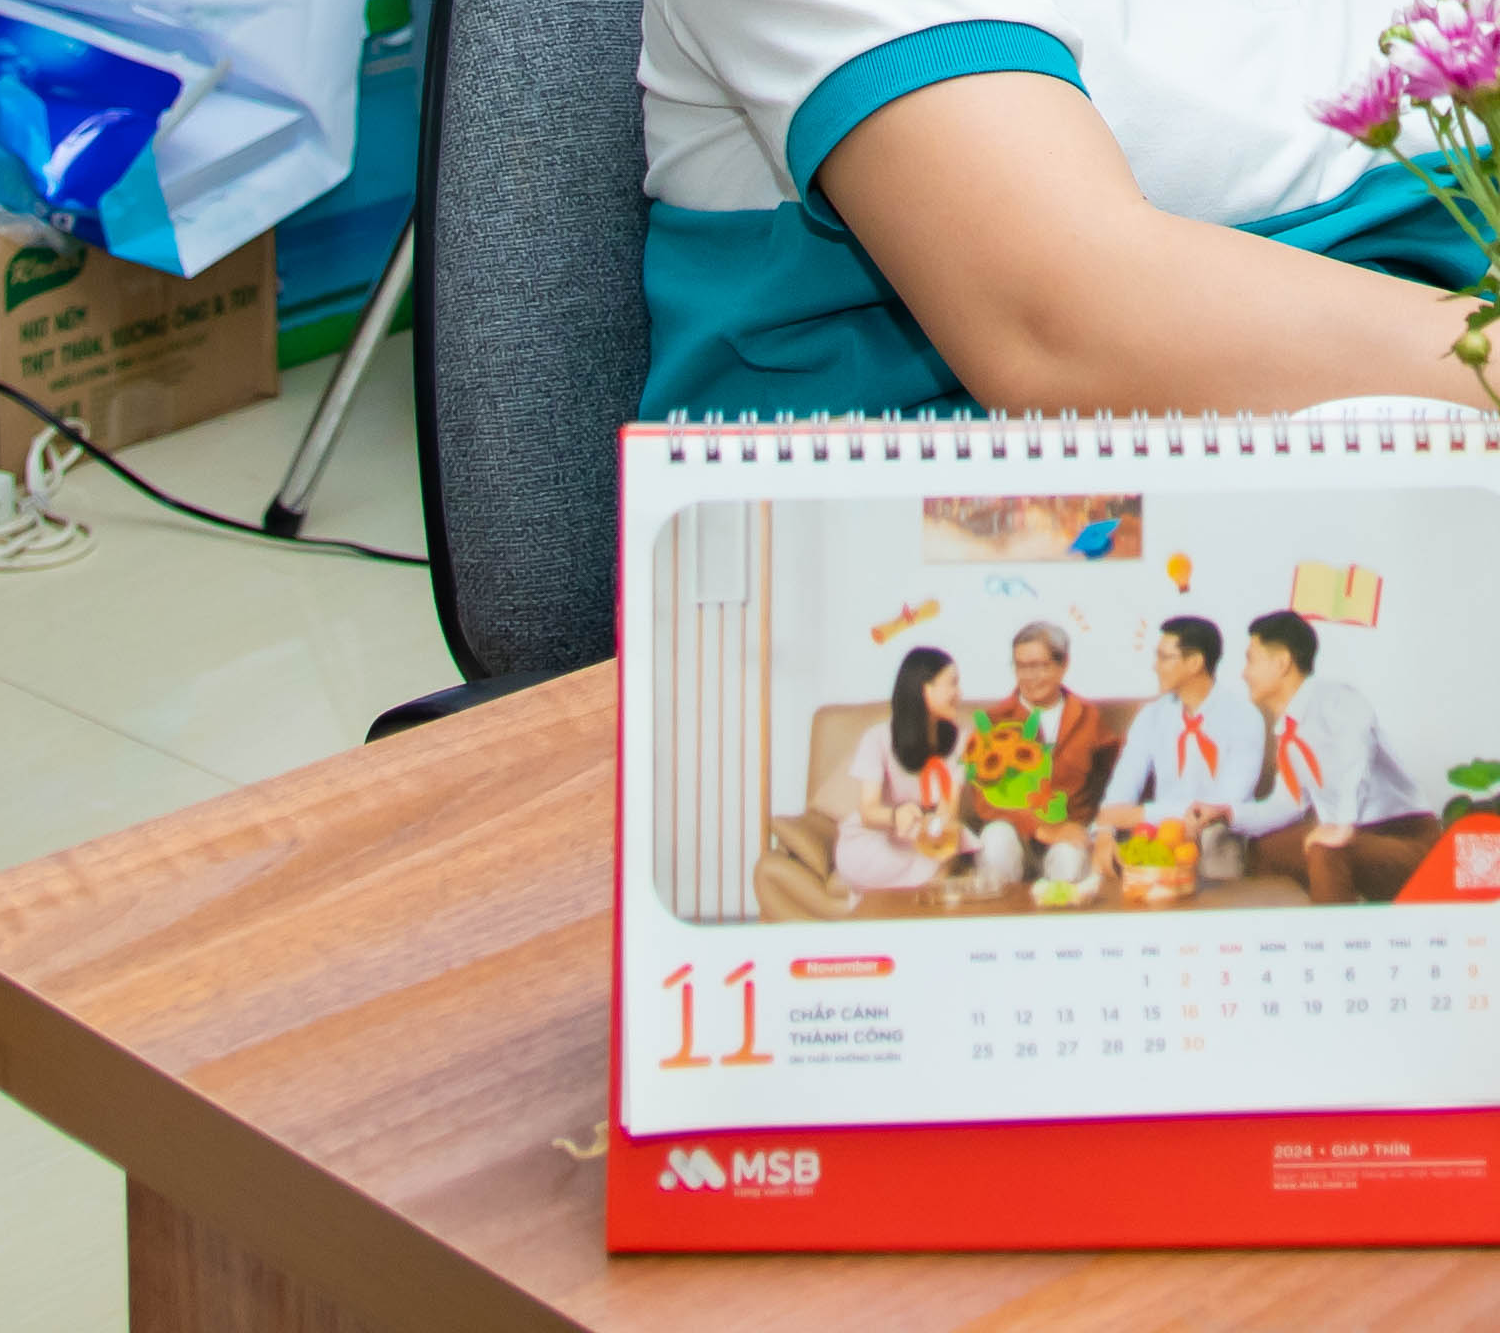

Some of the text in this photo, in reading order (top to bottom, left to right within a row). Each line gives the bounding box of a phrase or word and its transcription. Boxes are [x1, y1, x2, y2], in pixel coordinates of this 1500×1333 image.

[806, 961, 879, 976] November
[659, 960, 774, 1069] 11
[971, 1012, 986, 1025] 11
[1015, 1009, 1033, 1025] 12
[1057, 1008, 1075, 1023] 13
[1102, 1006, 1120, 1021] 14
[1144, 1005, 1161, 1021] 15
[1220, 1003, 1238, 1018] 17
[1261, 1001, 1279, 1016] 18
[1305, 1000, 1323, 1015] 19
[1346, 999, 1369, 1014] 20
[1390, 997, 1407, 1012] 21
[1430, 996, 1452, 1011] 22
[972, 1043, 994, 1059] 25
[1016, 1042, 1037, 1058] 26
[1057, 1041, 1079, 1056] 27
[1102, 1039, 1124, 1054] 28
[1144, 1037, 1166, 1052] 29
[1274, 1144, 1312, 1158] 2024
[733, 1151, 821, 1185] MSB
